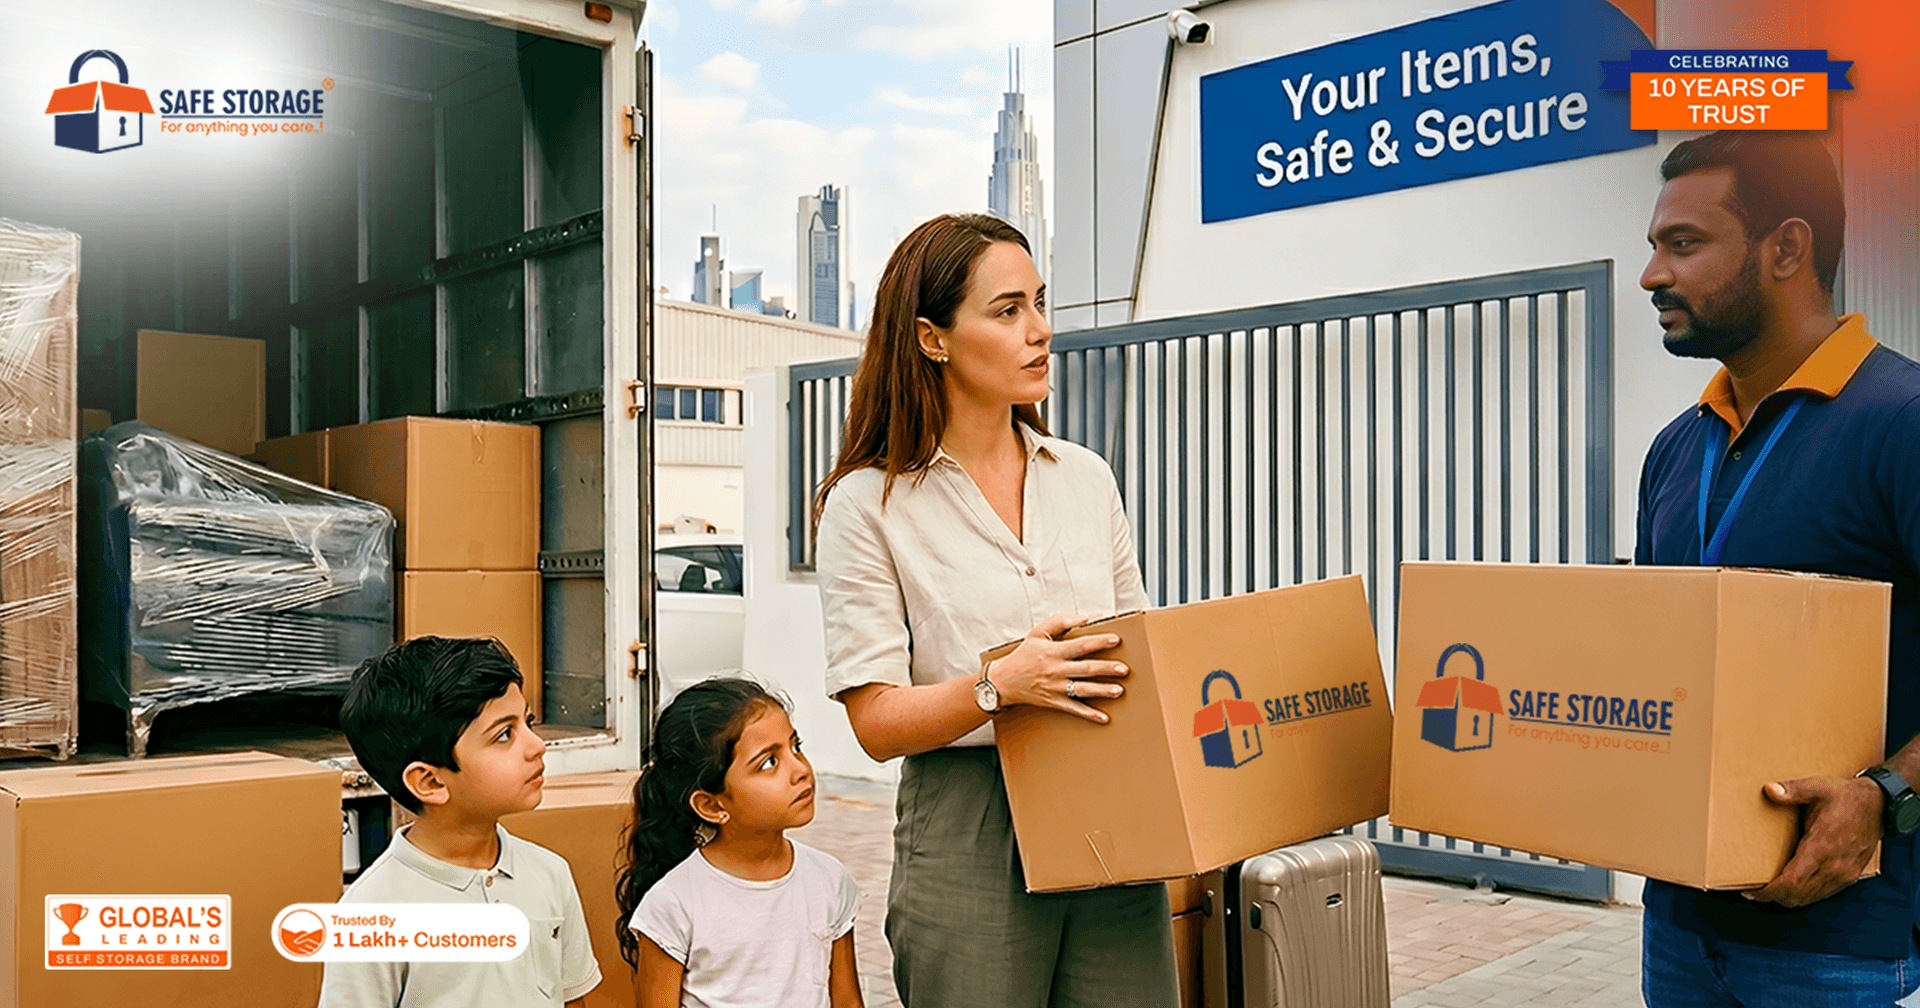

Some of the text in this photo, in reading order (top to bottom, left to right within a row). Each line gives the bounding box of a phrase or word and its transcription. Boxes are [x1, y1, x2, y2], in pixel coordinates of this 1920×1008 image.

[1281, 33, 1551, 121] Your Items,
[1255, 91, 1588, 188] Safe & Secure
[1264, 681, 1371, 722] SAFE STORAGE
[1508, 689, 1560, 719] SAFE
[1508, 724, 1528, 738] For
[1530, 727, 1591, 750] anything
[1593, 734, 1621, 750] you
